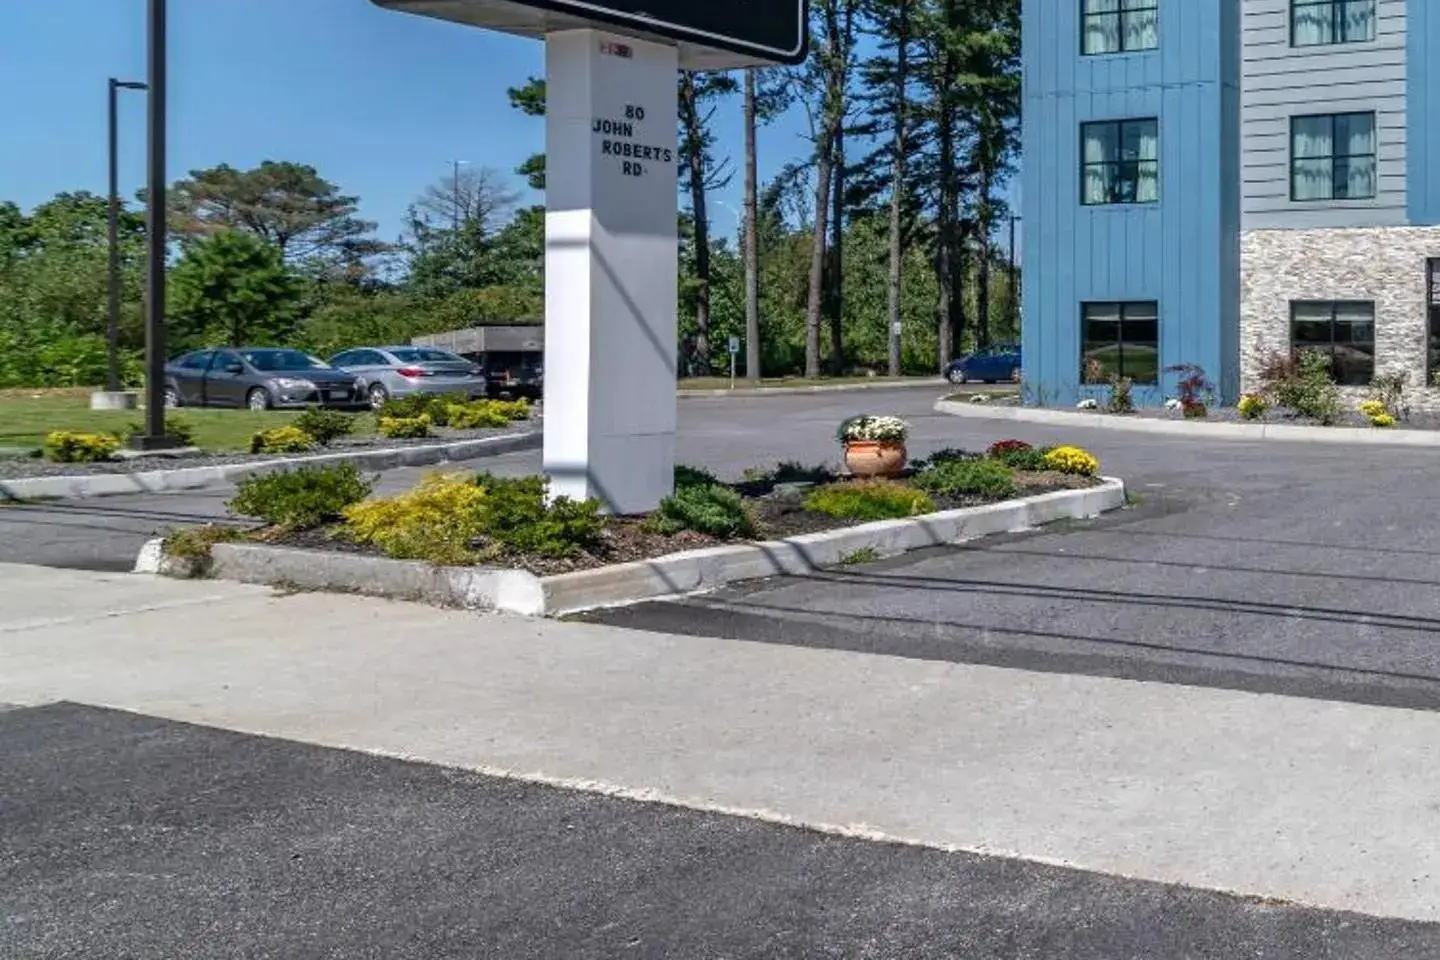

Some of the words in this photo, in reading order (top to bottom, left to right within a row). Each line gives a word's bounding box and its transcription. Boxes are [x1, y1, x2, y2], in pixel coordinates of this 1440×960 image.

[625, 104, 645, 121] 80
[592, 120, 633, 137] JOHN
[602, 140, 671, 162] ROBERTS
